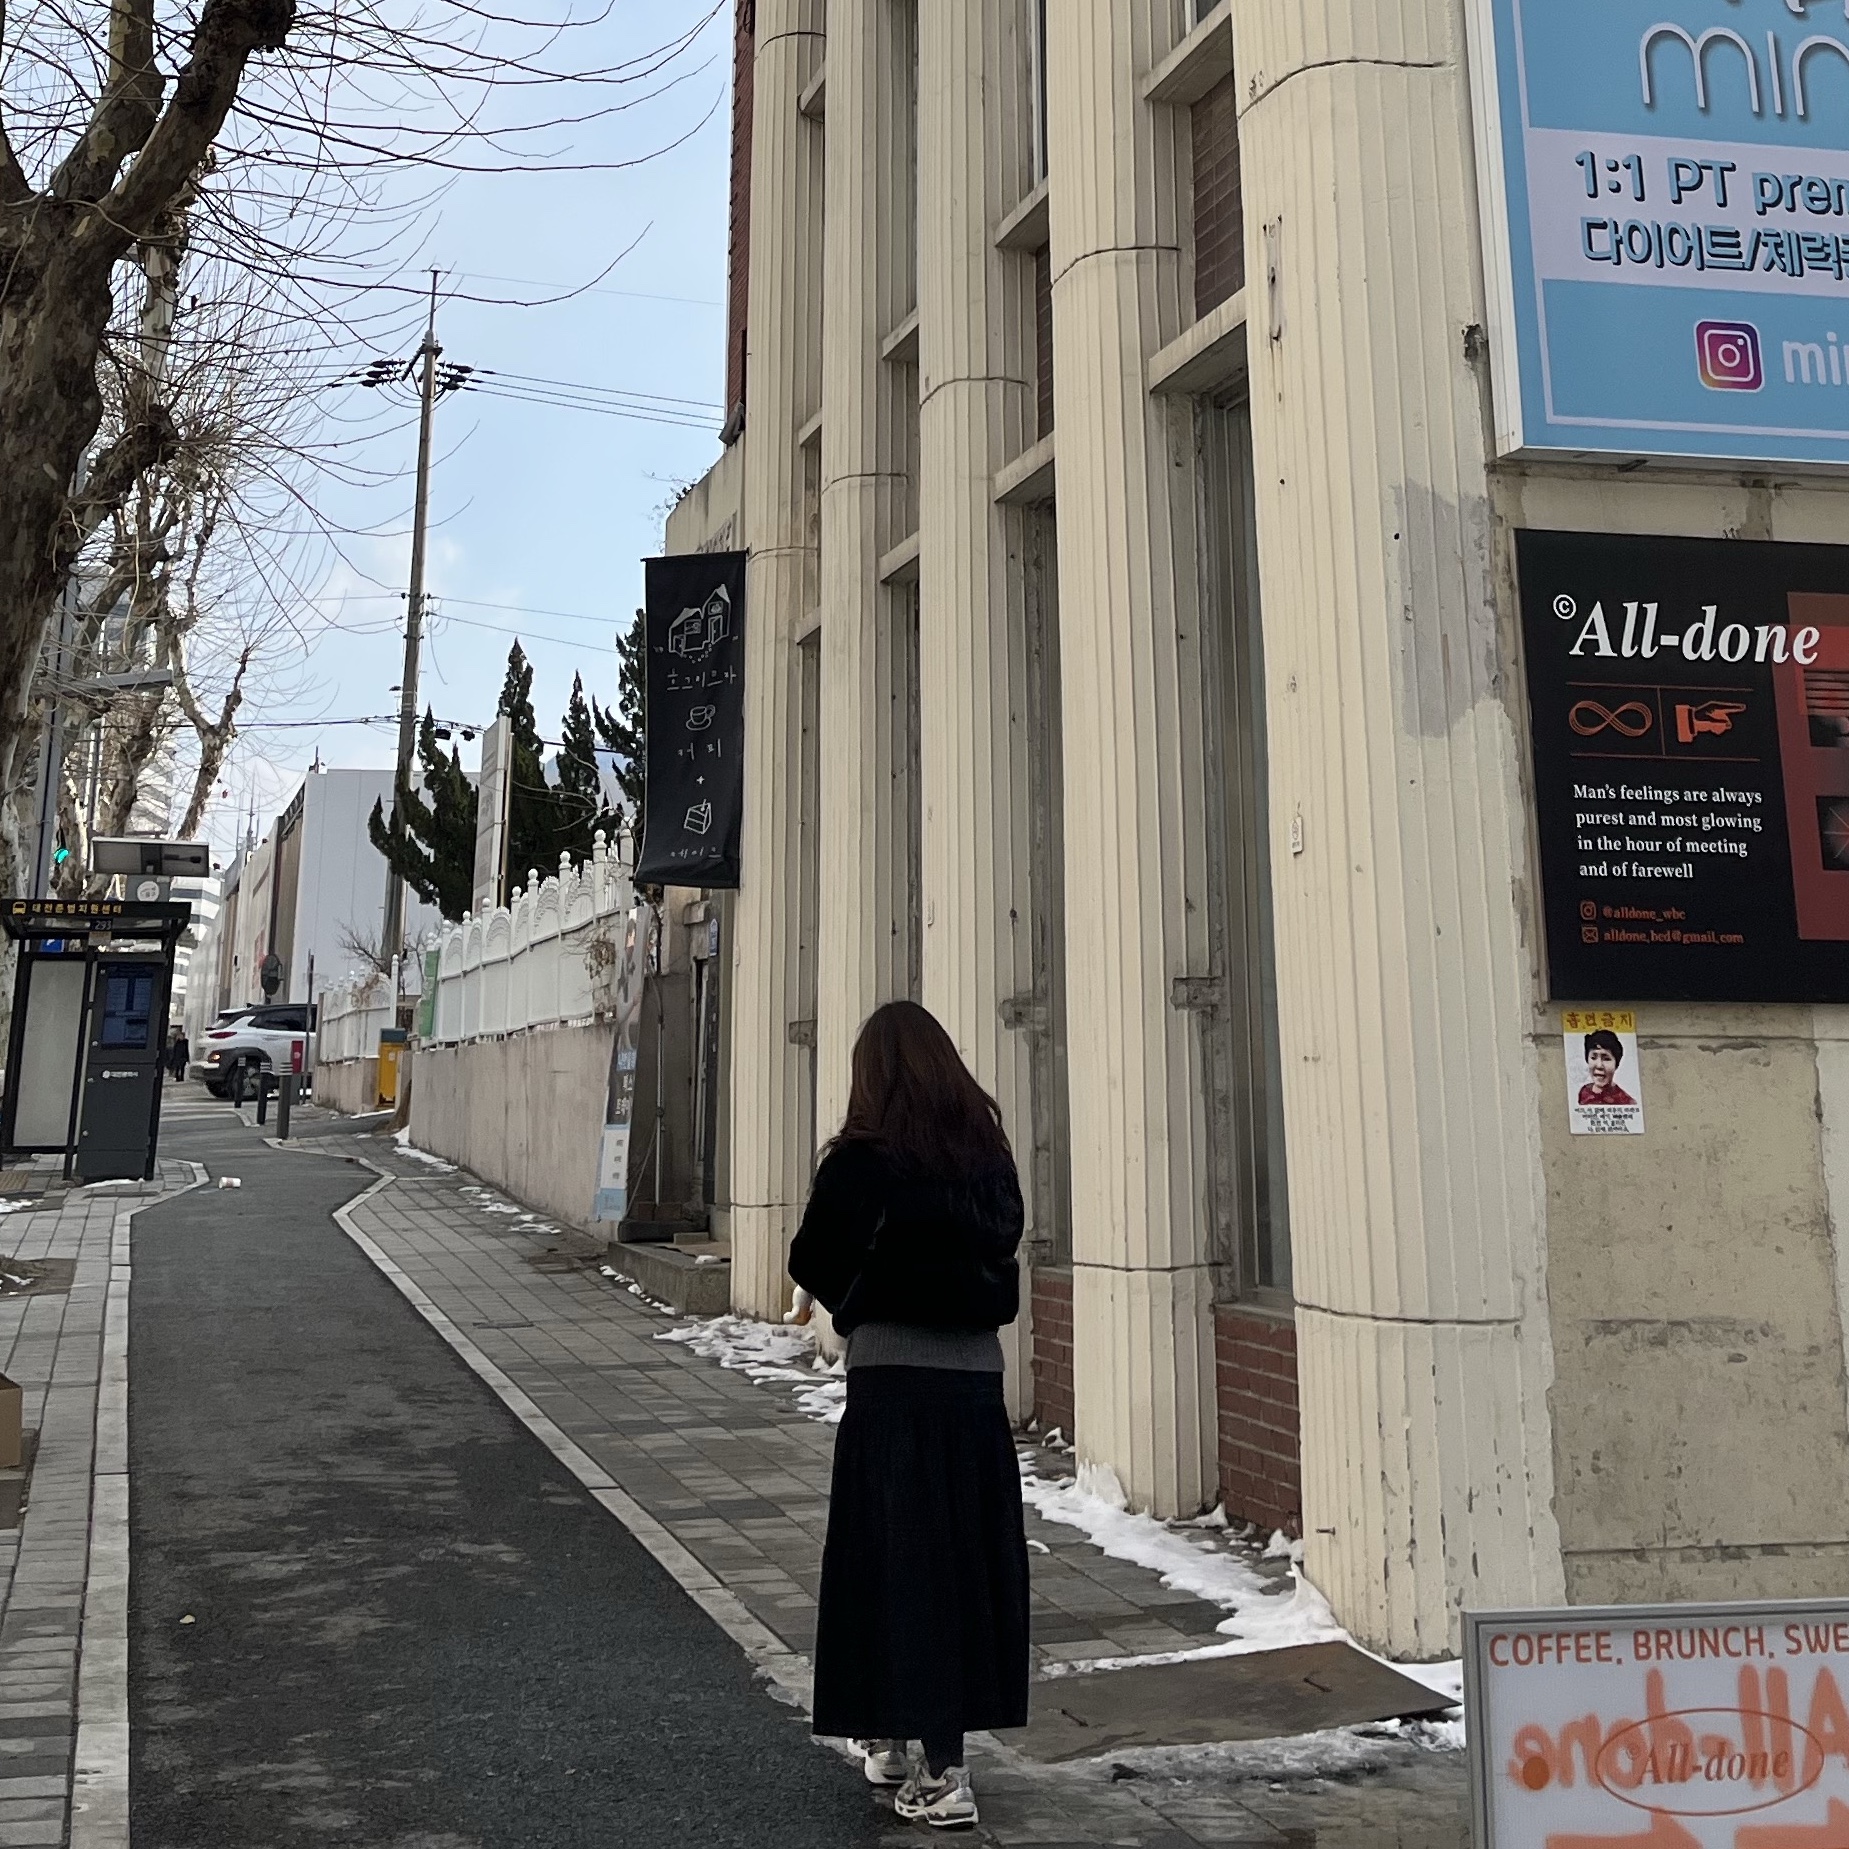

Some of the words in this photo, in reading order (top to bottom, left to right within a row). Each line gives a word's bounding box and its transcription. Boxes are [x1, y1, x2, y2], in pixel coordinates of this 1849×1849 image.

[1575, 150, 1646, 202] 1:1
[1667, 156, 1737, 208] PT
[1580, 216, 1849, 281] 다이어트/체력
[1620, 785, 1680, 805] feelings
[1684, 789, 1708, 802] are
[1712, 788, 1762, 806] always
[1575, 811, 1625, 828] purest
[1628, 811, 1657, 826] and
[1661, 813, 1698, 827] most
[1701, 812, 1762, 832] glowing
[1577, 835, 1593, 850] in
[1597, 836, 1622, 851] the
[1626, 836, 1662, 852] hour
[1666, 837, 1682, 852] of
[1685, 838, 1748, 857] meeting
[1579, 861, 1608, 876] and
[1612, 861, 1628, 877] of
[1632, 861, 1694, 878] farewell
